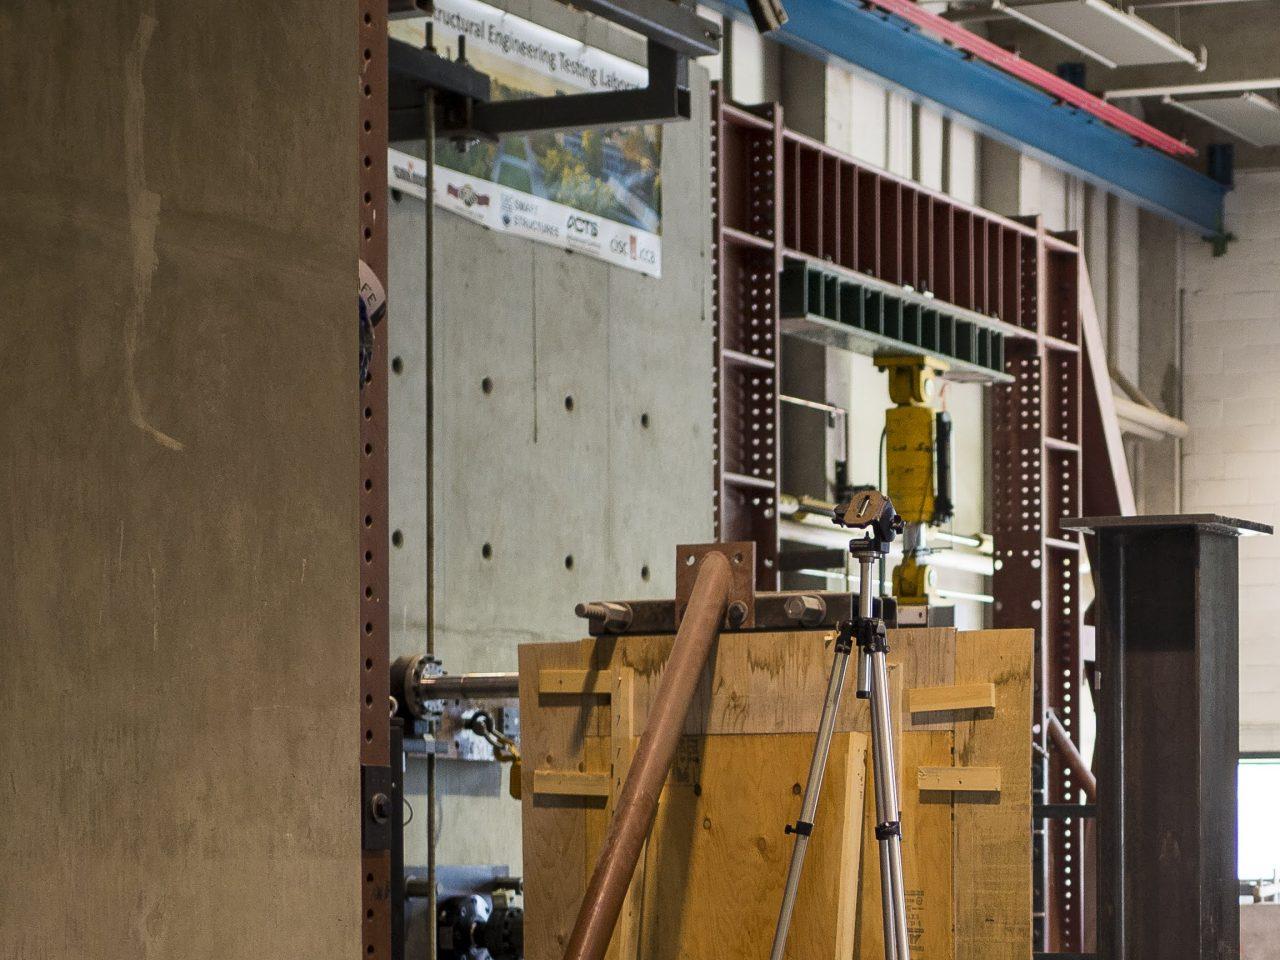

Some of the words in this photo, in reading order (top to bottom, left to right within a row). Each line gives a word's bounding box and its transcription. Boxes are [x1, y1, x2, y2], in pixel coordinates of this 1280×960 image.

[487, 23, 556, 72] Engineering
[559, 51, 598, 87] Testing
[567, 215, 599, 237] ACTS
